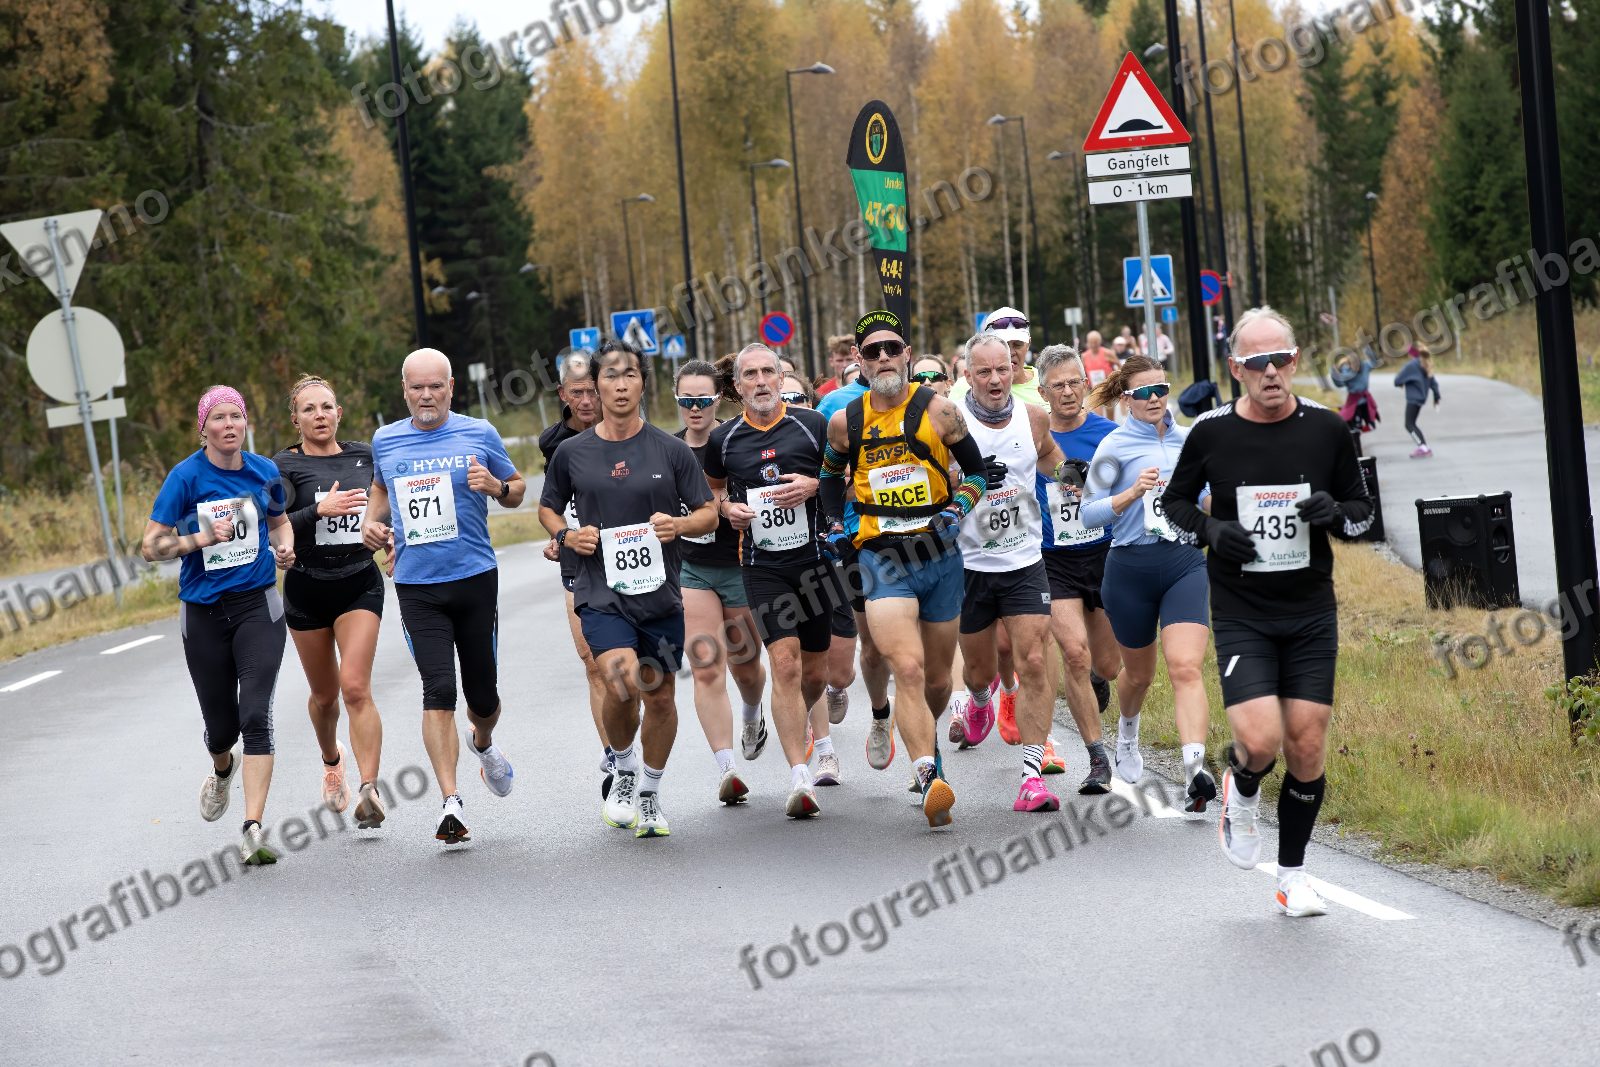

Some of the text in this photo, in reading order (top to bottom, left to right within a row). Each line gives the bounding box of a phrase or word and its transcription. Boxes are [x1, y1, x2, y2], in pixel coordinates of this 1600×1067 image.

[1107, 153, 1170, 171] Gangfelt
[1112, 185, 1122, 198] 0
[1137, 183, 1143, 196] 1
[1147, 182, 1169, 195] km
[864, 200, 906, 232] 47:30
[880, 466, 916, 479] NORGES
[406, 476, 441, 488] NORGES
[885, 473, 912, 485] LØPET
[410, 483, 436, 494] LØPET
[986, 488, 1019, 501] NORGES
[878, 484, 926, 506] PACE
[990, 495, 1015, 507] LØPET
[1254, 491, 1299, 500] NORGES
[210, 502, 245, 513] NORGES
[408, 495, 442, 520] 671
[1257, 499, 1292, 508] LØPET
[326, 513, 361, 534] 542
[760, 507, 796, 529] 380
[989, 505, 1020, 531] 697
[423, 523, 456, 535] Aurskog
[614, 527, 649, 539] NORGES
[1252, 515, 1298, 540] 435
[617, 535, 644, 545] LØPET
[777, 531, 808, 543] Aurskog
[227, 547, 258, 559] Aurskog
[615, 546, 652, 571] 838
[1268, 549, 1308, 561] Aurskog
[632, 575, 665, 586] Aurskog
